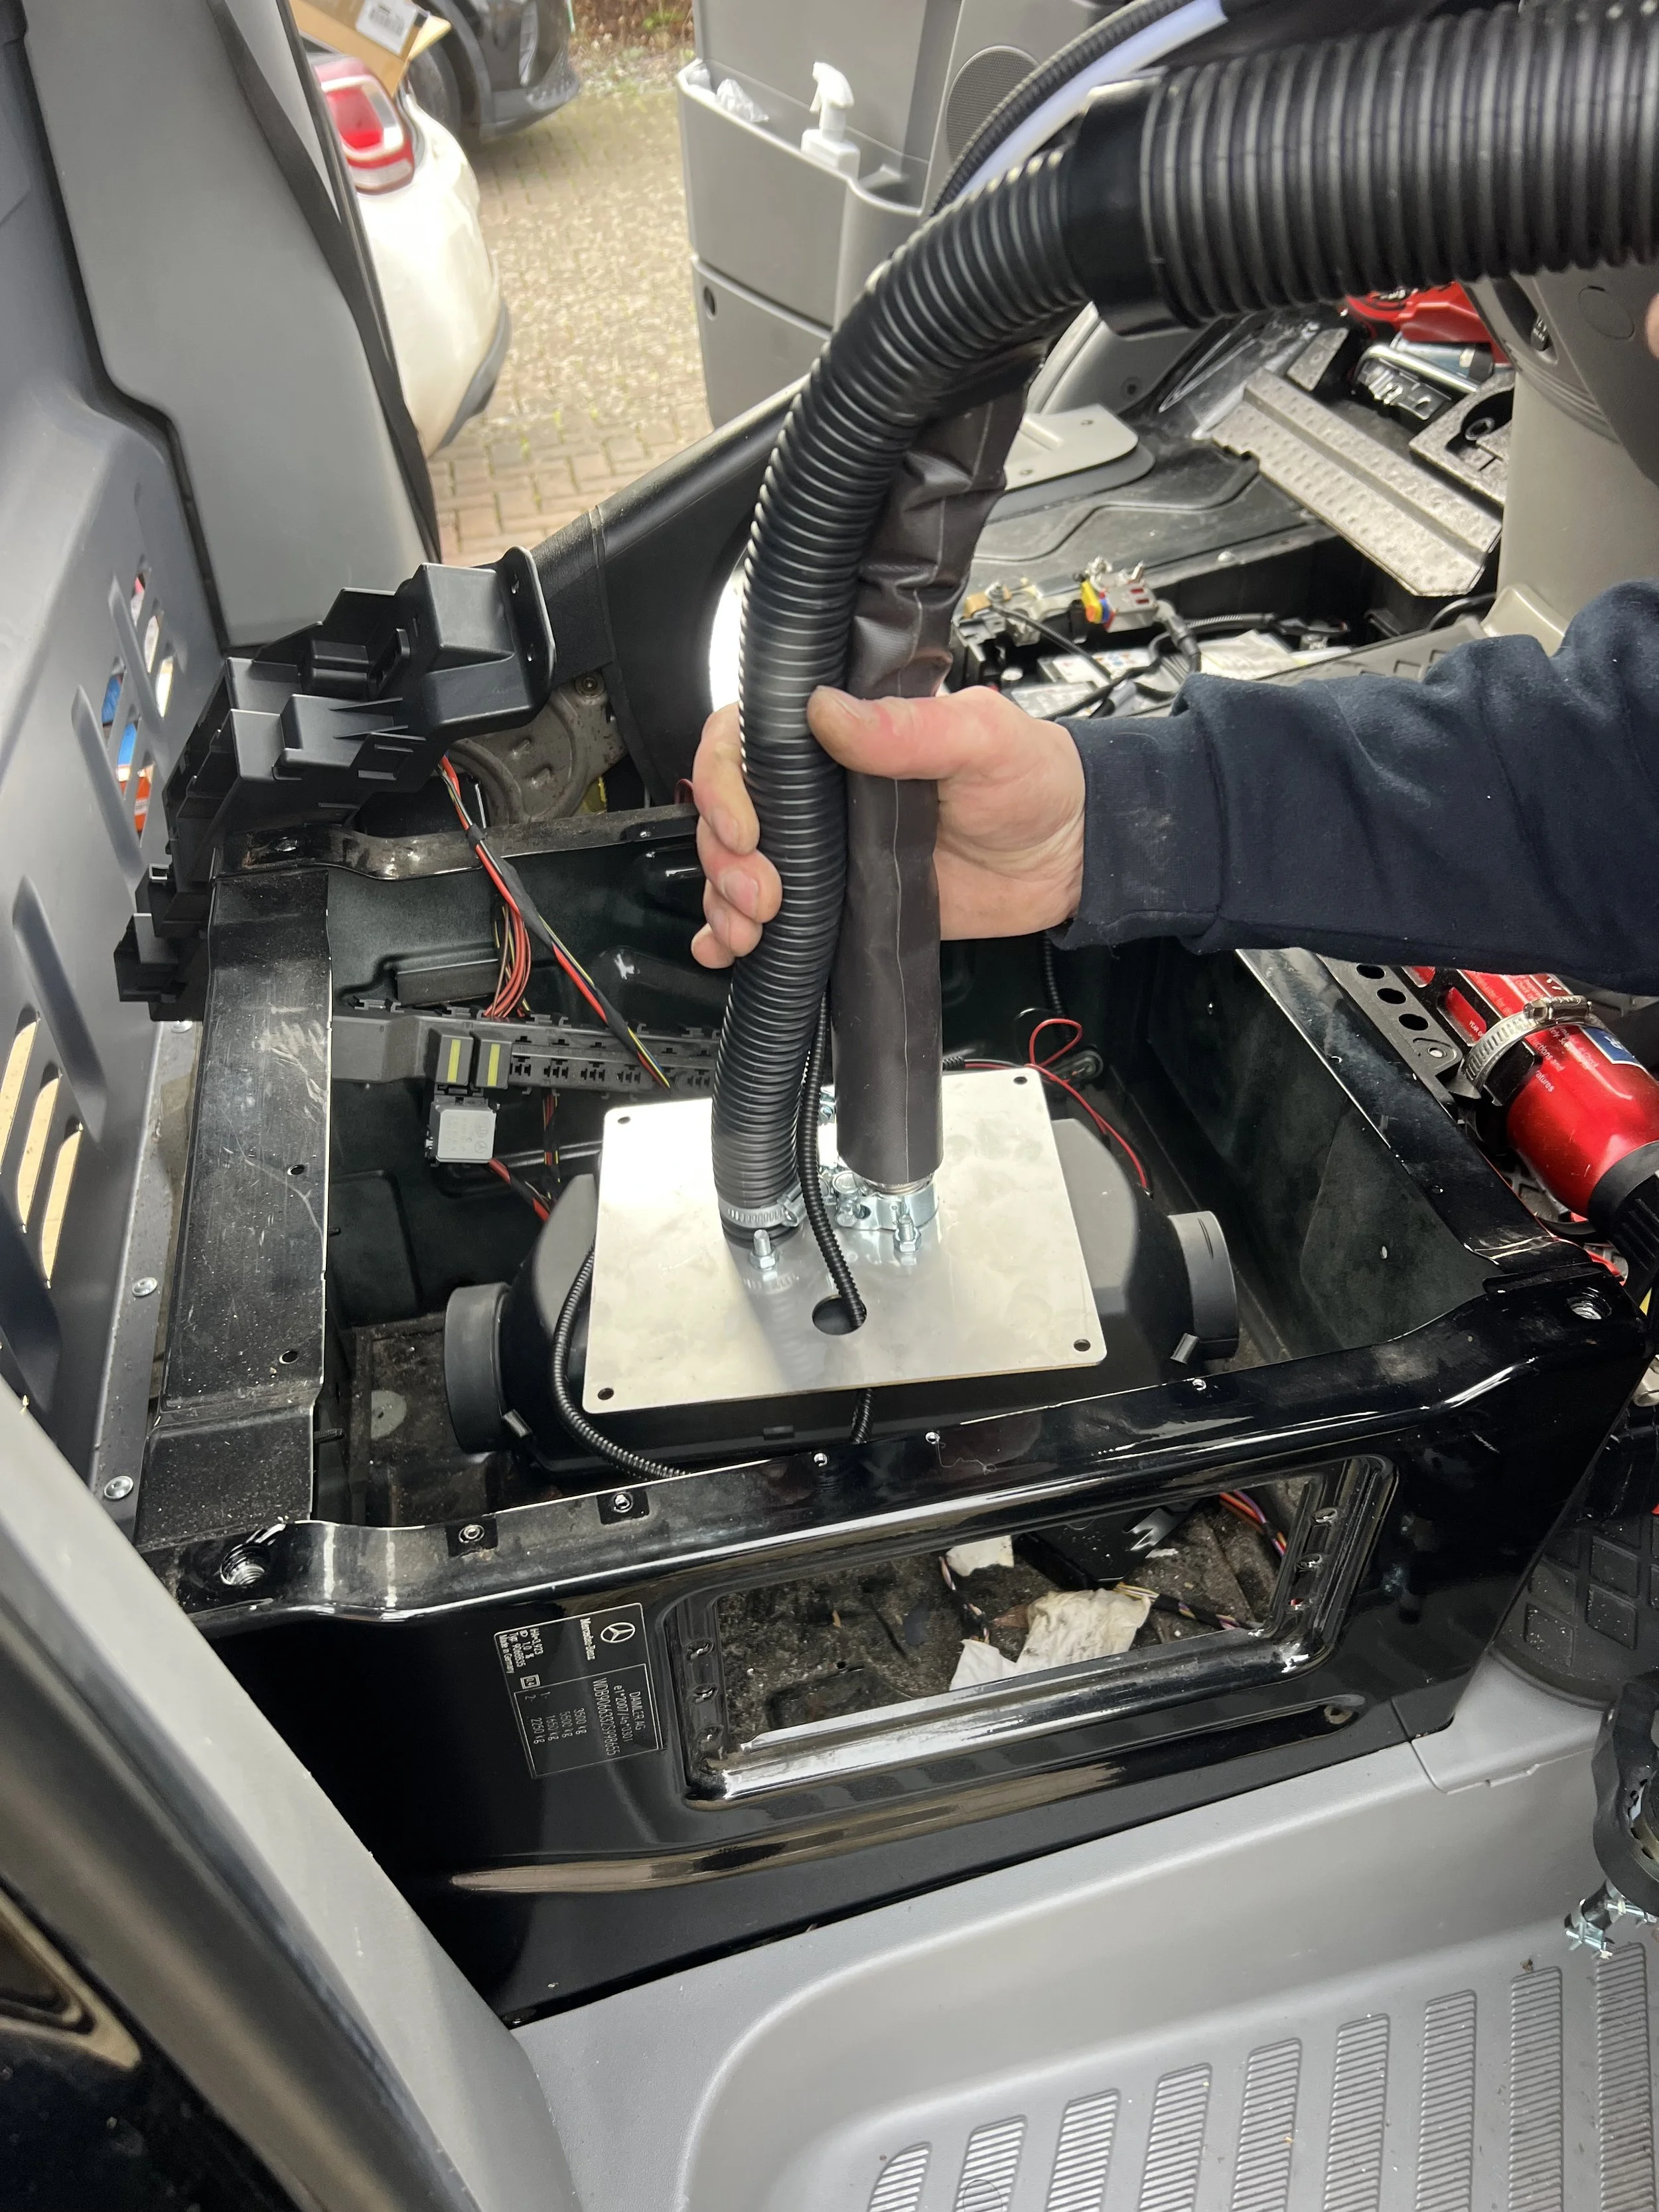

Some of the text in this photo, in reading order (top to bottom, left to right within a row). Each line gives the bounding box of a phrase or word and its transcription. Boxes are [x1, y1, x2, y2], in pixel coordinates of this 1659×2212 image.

[1469, 1020, 1479, 1032] YEAR
[580, 1617, 595, 1660] Mercedes-Benz
[499, 1635, 508, 1648] Made
[504, 1653, 514, 1673] Germany
[629, 1691, 646, 1730] DAIMLER AG
[531, 1718, 544, 1733] 2250
[546, 1715, 558, 1730] 1650
[559, 1711, 573, 1737] 5500 kg
[573, 1708, 587, 1734] 3500 kg
[534, 1735, 545, 1743] kg
[547, 1732, 559, 1741] kg
